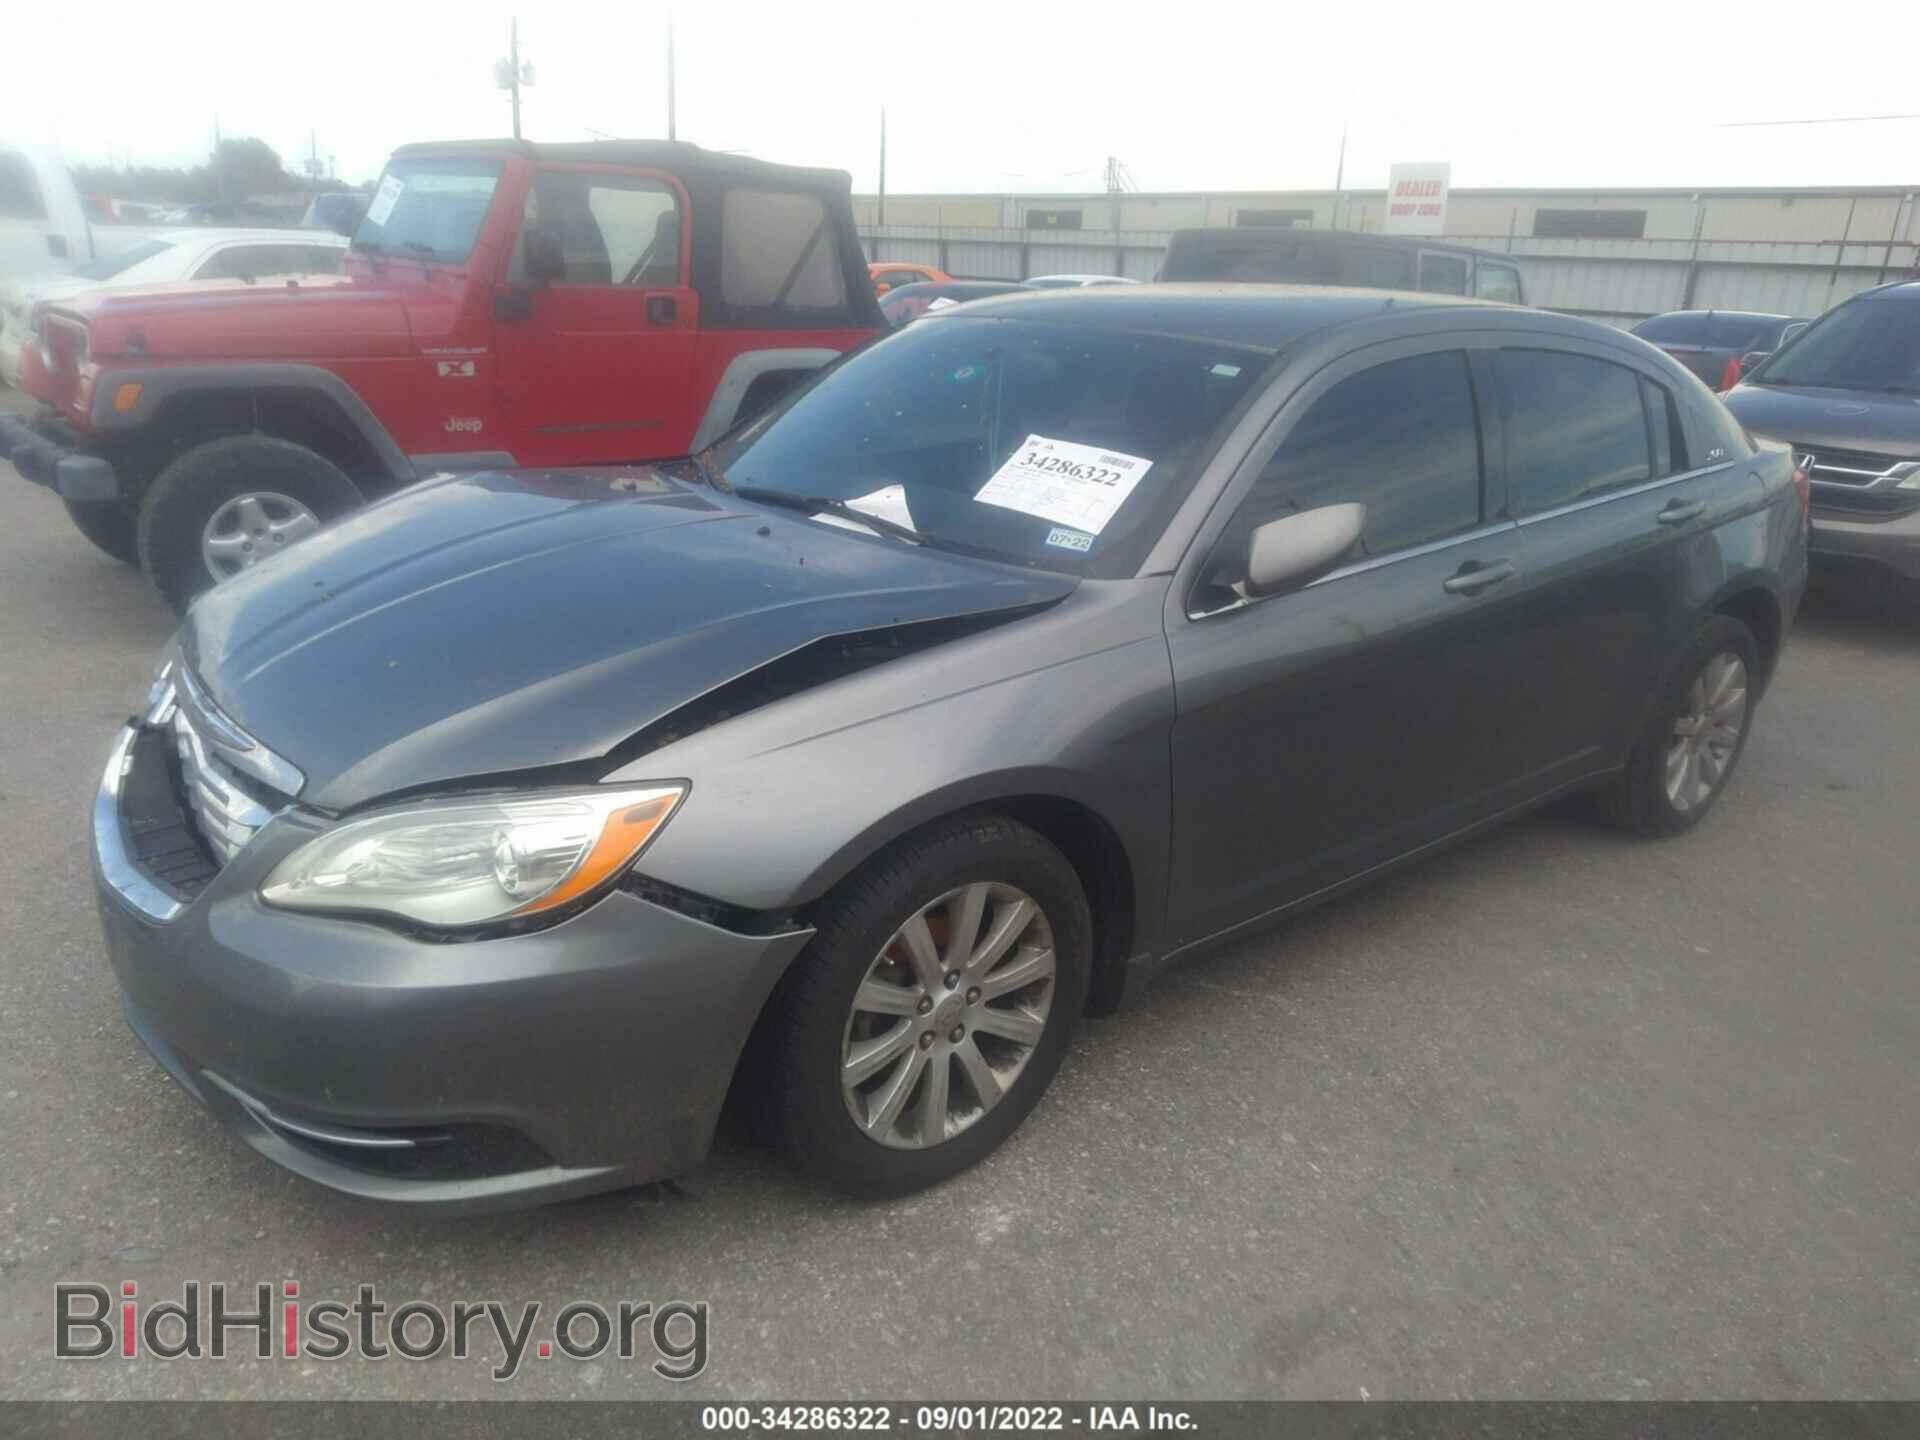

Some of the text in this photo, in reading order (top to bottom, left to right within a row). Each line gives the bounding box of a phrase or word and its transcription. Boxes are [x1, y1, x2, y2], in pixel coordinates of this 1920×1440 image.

[1393, 180, 1442, 197] DEALER
[444, 415, 483, 433] Jeep
[1020, 452, 1122, 487] 34286322
